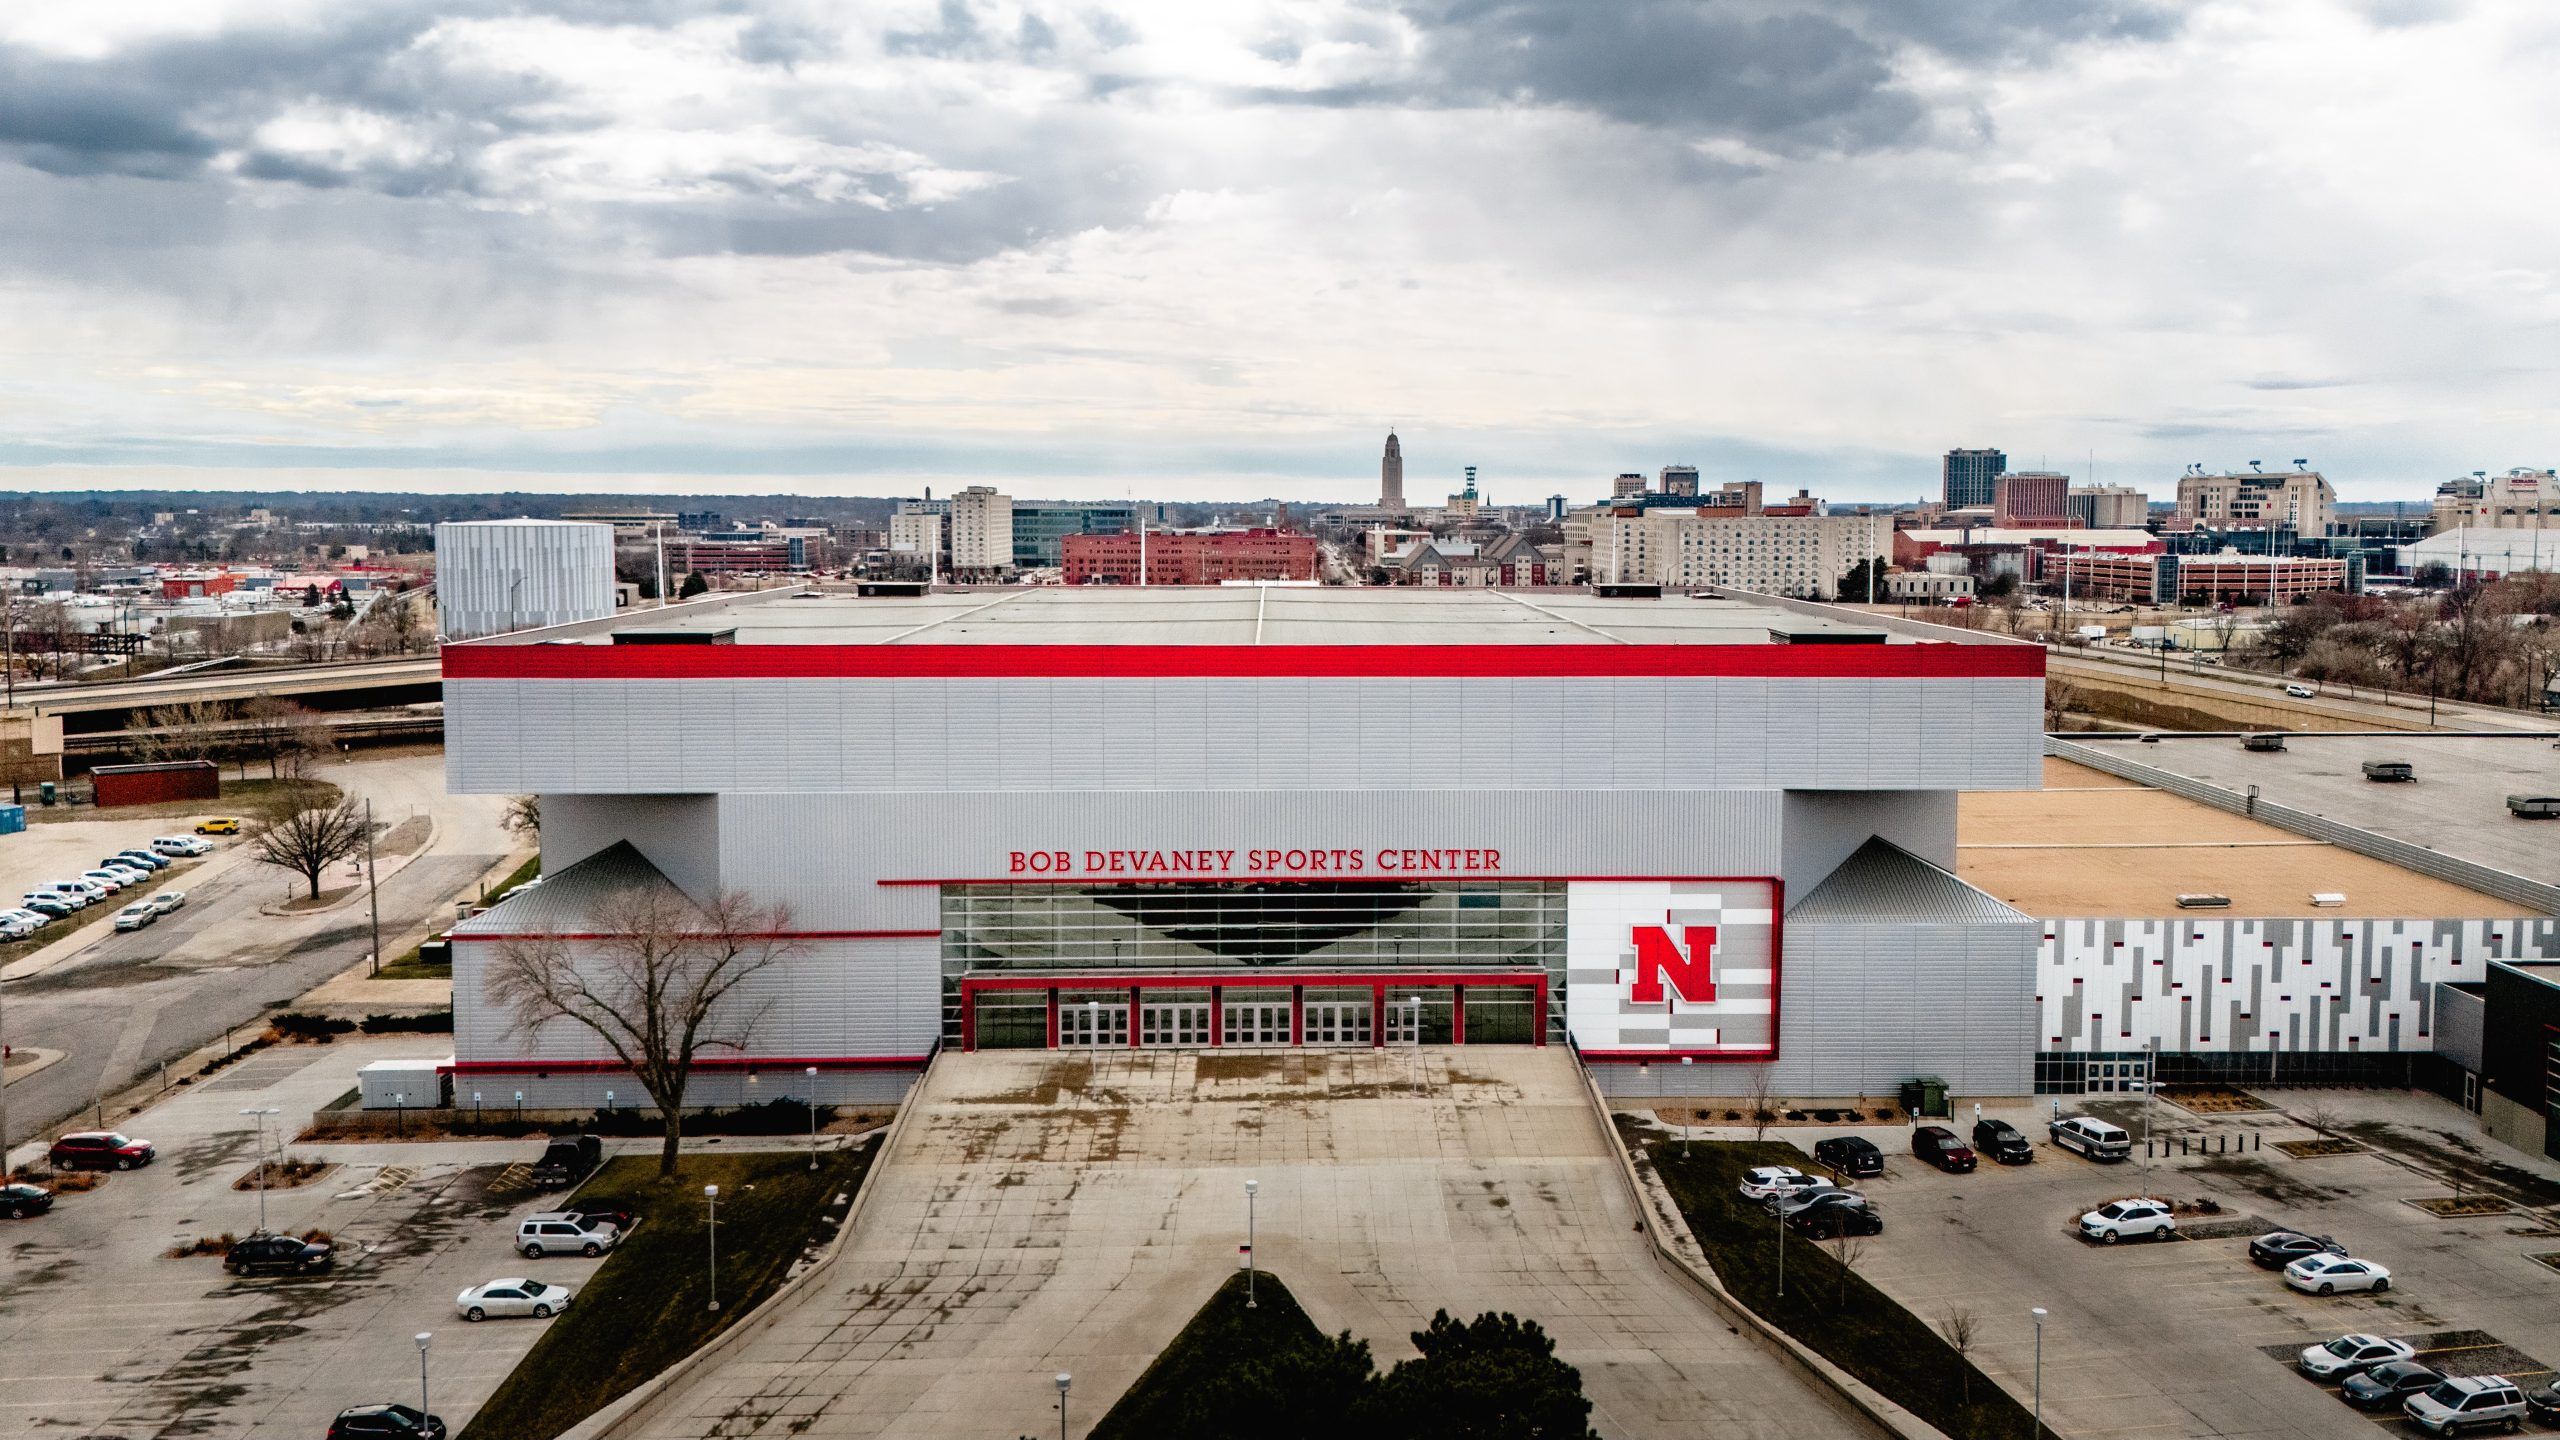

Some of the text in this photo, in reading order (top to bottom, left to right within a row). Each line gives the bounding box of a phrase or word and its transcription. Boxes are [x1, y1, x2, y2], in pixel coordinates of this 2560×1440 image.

[1009, 848, 1501, 874] BOB DEVANEY SPORTS CENTER
[1630, 924, 1718, 1004] N
